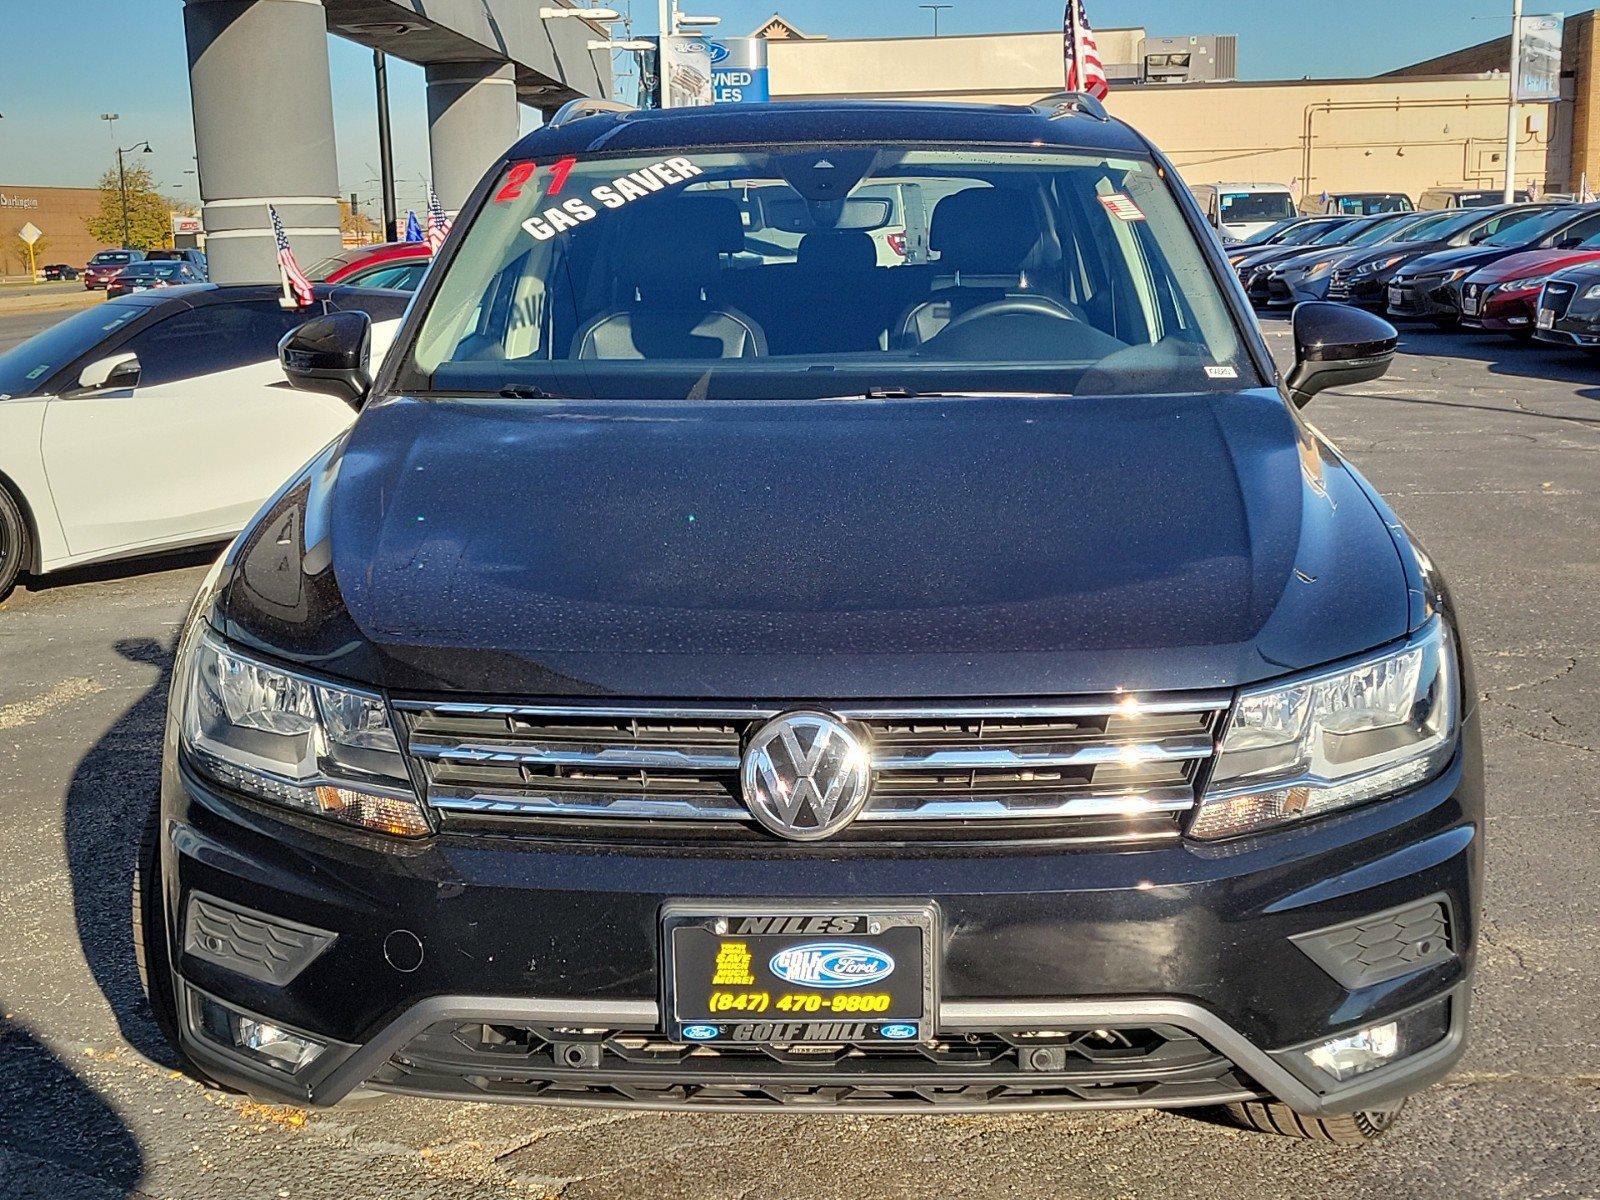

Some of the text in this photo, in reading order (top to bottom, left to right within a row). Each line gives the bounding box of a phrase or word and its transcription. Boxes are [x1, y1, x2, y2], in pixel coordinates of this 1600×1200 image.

[521, 156, 704, 241] GAS SAVER
[737, 916, 859, 934] NILES
[833, 956, 878, 974] Ford
[709, 992, 891, 1012] (847) 470-9800
[732, 1022, 866, 1041] GOLF MILL
